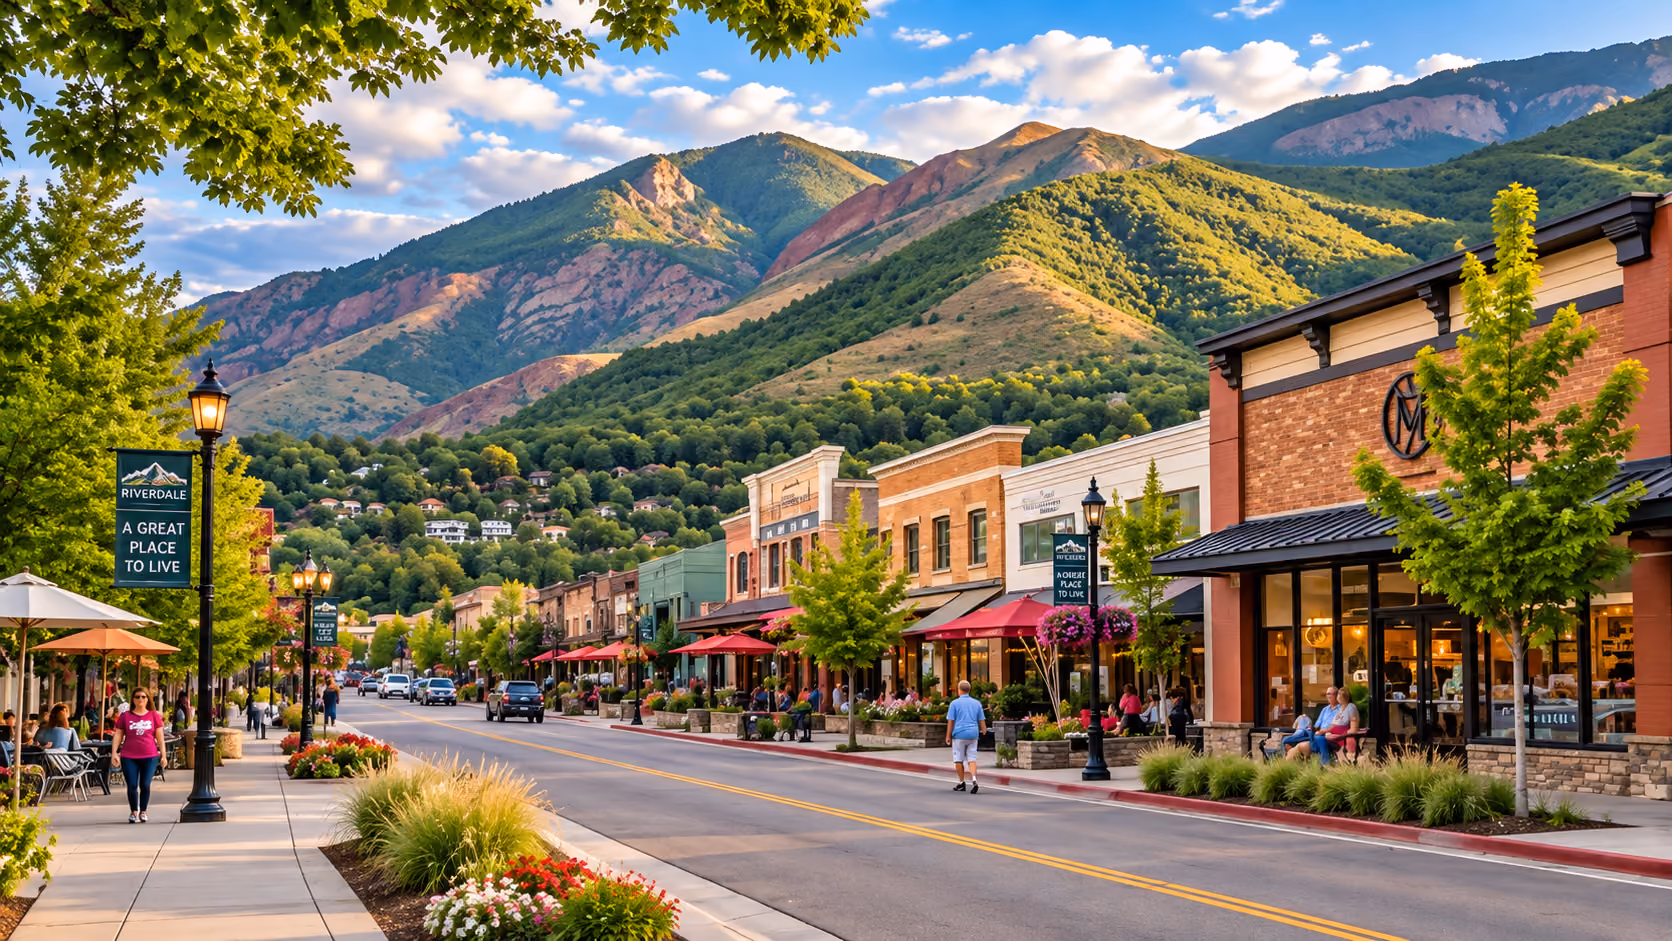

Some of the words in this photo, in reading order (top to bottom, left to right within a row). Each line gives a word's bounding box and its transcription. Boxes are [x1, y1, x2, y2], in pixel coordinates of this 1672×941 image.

[121, 488, 187, 500] RIVERDALE
[122, 522, 132, 534] A
[137, 522, 185, 535] GREAT
[130, 541, 176, 554] PLACE
[125, 560, 144, 572] TO
[149, 560, 180, 573] LIVE
